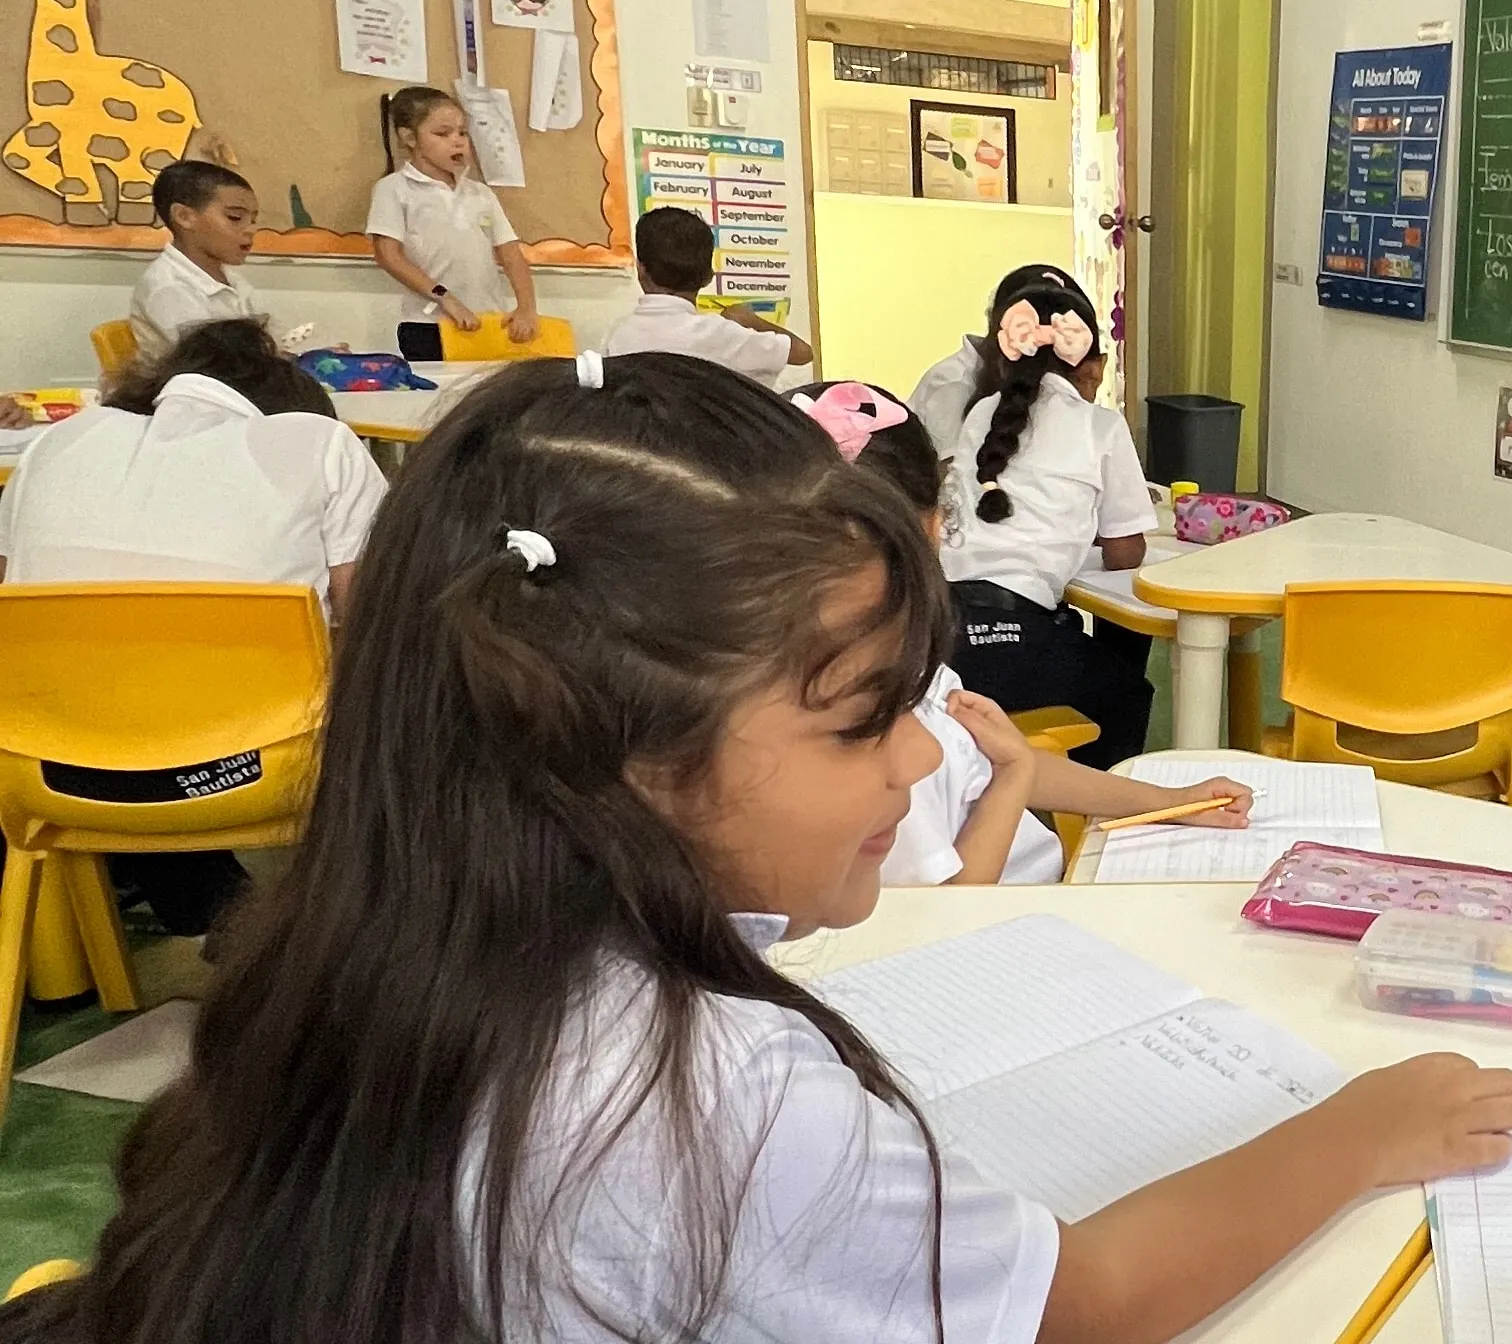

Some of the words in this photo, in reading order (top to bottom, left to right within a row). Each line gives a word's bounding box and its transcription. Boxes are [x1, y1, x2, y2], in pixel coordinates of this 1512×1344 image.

[1352, 68, 1365, 88] All
[1365, 67, 1392, 87] About
[1392, 65, 1422, 90] Today
[641, 131, 711, 150] Months
[735, 140, 777, 154] Year
[655, 157, 705, 172] January
[740, 164, 763, 175] July
[653, 182, 709, 197] February
[732, 187, 773, 200] August
[720, 209, 785, 222] September
[731, 234, 779, 245] October
[726, 257, 787, 269] November
[1484, 259, 1508, 281] cen
[727, 281, 787, 292] December
[967, 623, 989, 635] San
[992, 621, 1021, 633] Juan
[969, 632, 1020, 646] Bautista
[176, 770, 210, 788] San
[215, 751, 256, 774] Juan
[185, 763, 261, 798] Bautista
